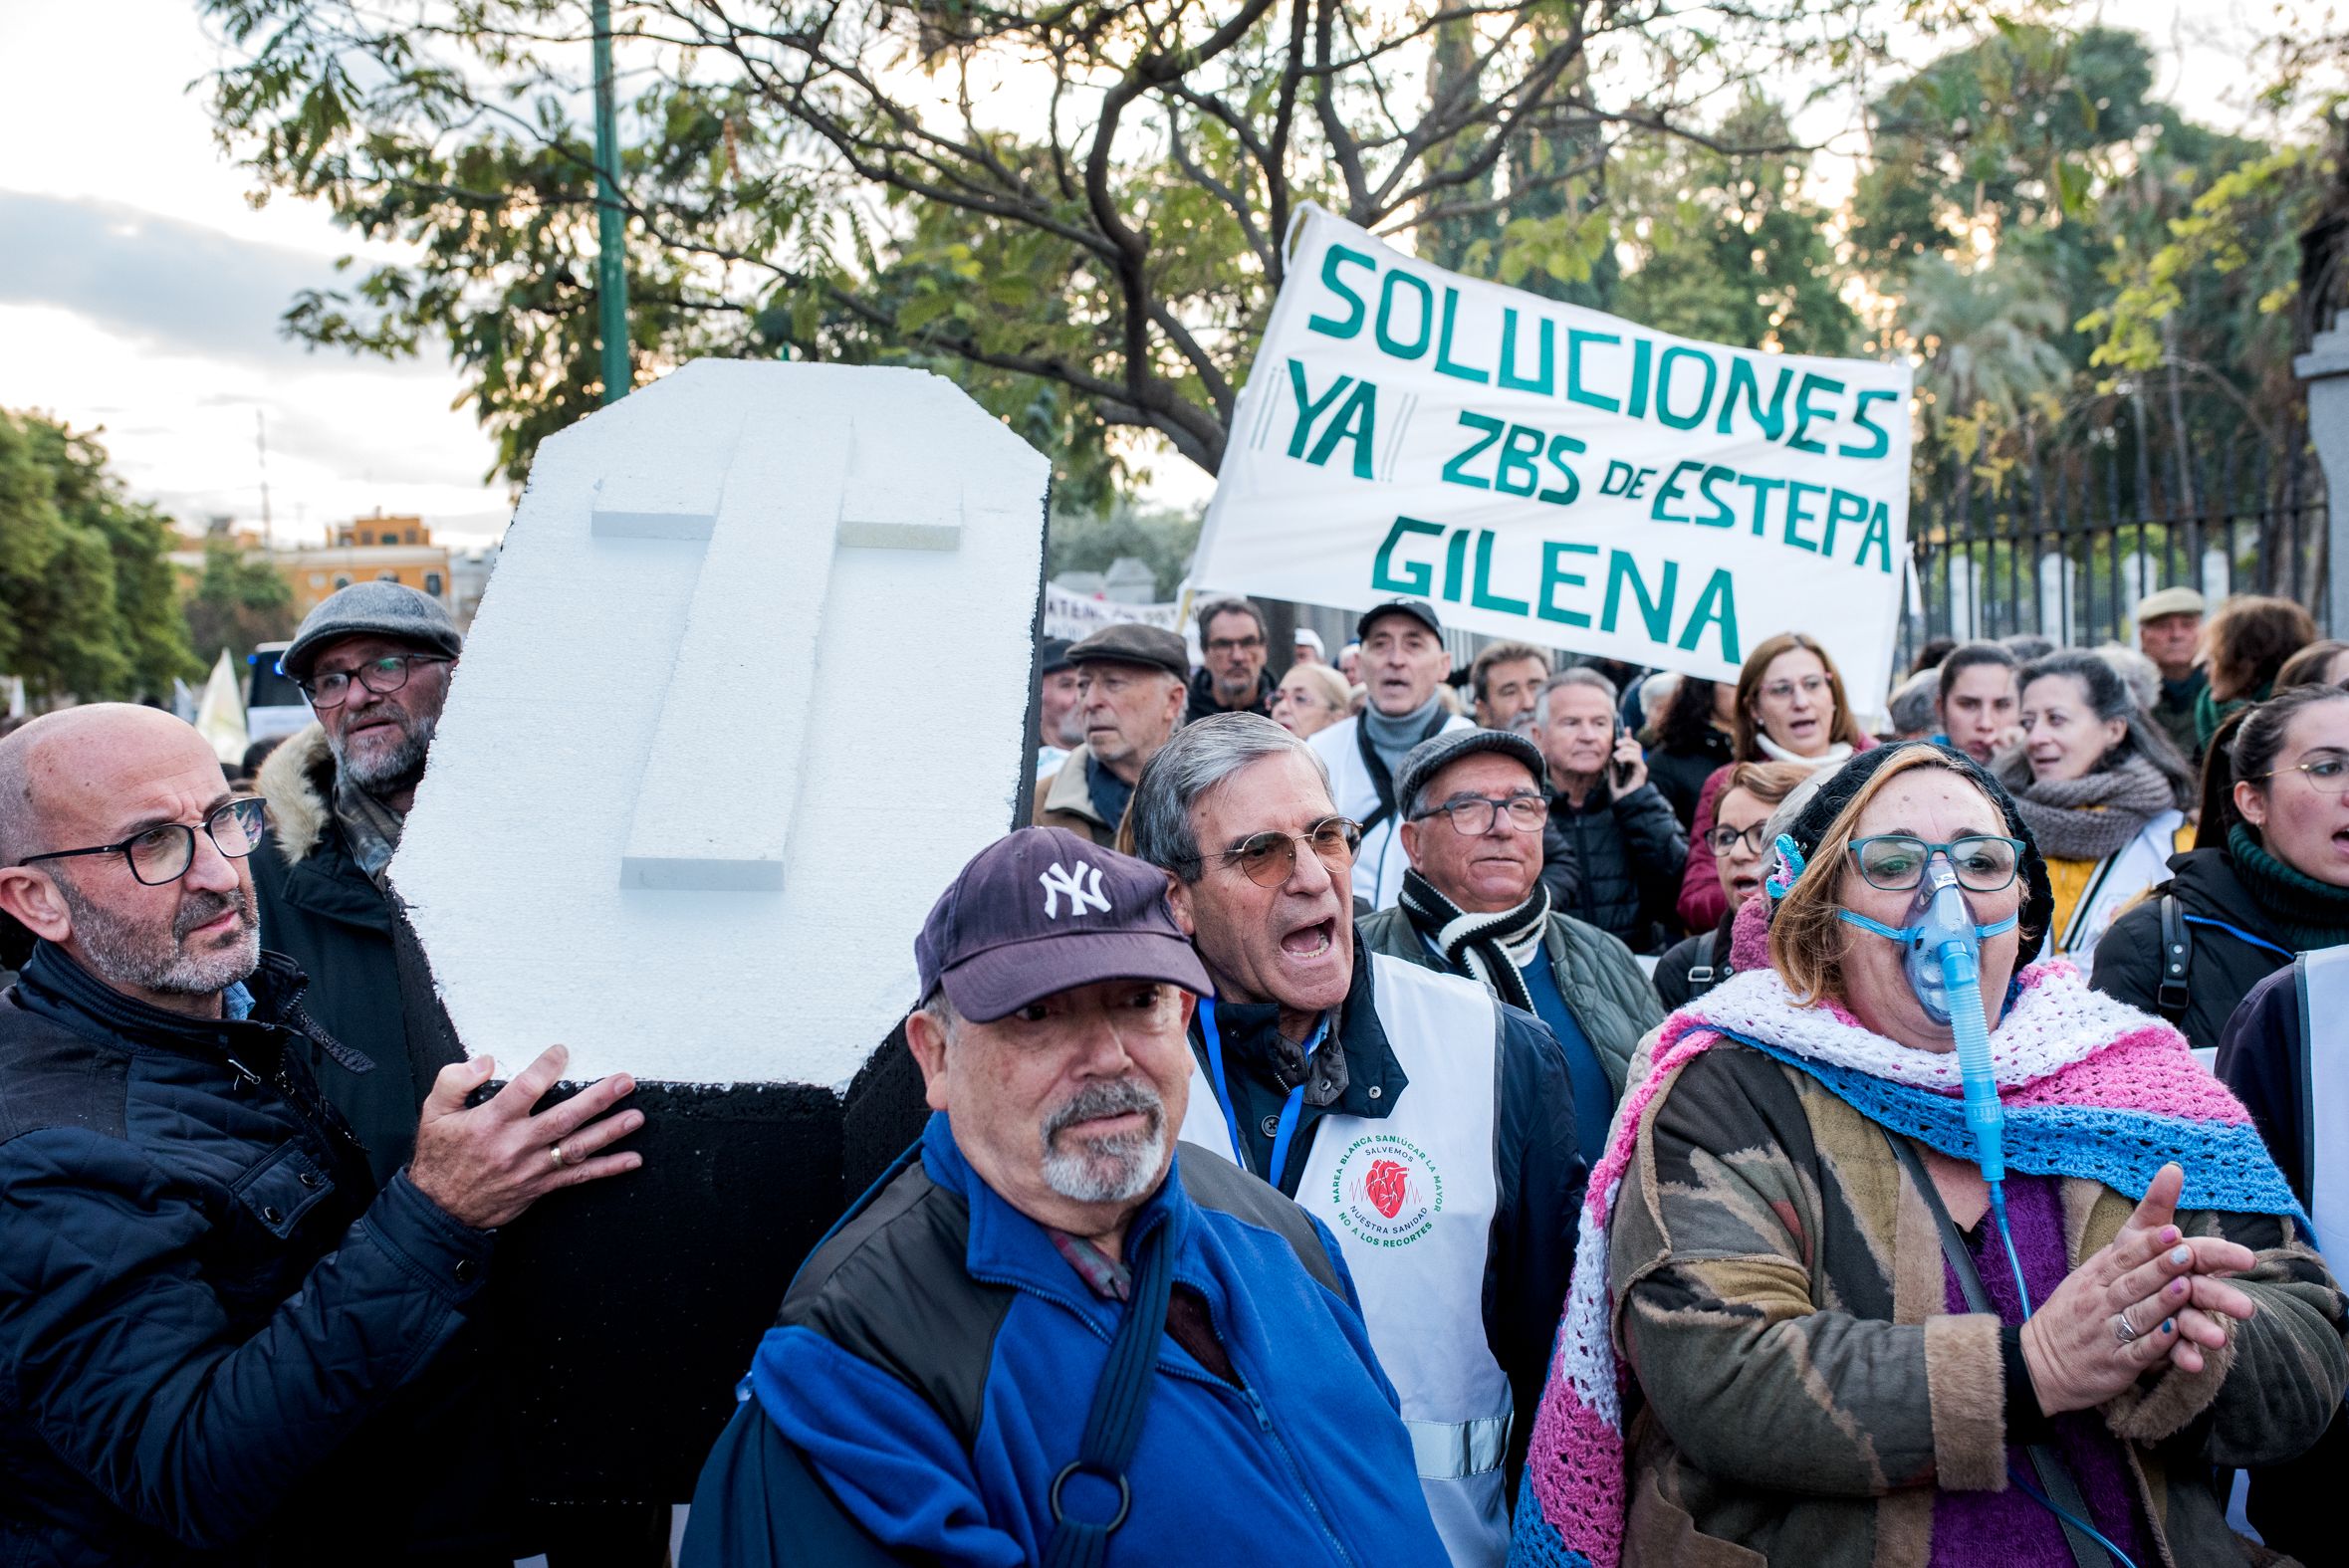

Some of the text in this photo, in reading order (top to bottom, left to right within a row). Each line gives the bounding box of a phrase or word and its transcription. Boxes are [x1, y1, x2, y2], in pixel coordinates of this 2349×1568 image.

[1307, 242, 1900, 461] SOLUCIONES
[1441, 409, 1588, 506] ZBS
[1598, 459, 1659, 500] DE
[1649, 459, 1893, 574] ESTEPA
[1370, 515, 1743, 666] GILENA
[1039, 859, 1112, 920] NY
[1332, 1168, 1343, 1204] MAREA
[1339, 1136, 1373, 1165] BLANCA
[1425, 1159, 1436, 1173] LA
[1433, 1175, 1443, 1213] MAYOR
[1364, 1146, 1414, 1163] SALVEMOS
[1338, 1212, 1351, 1227] NO
[1359, 1232, 1380, 1246] LOS
[1382, 1222, 1433, 1247] RECORTES
[1349, 1205, 1428, 1234] NUESTRA SANIDAD
